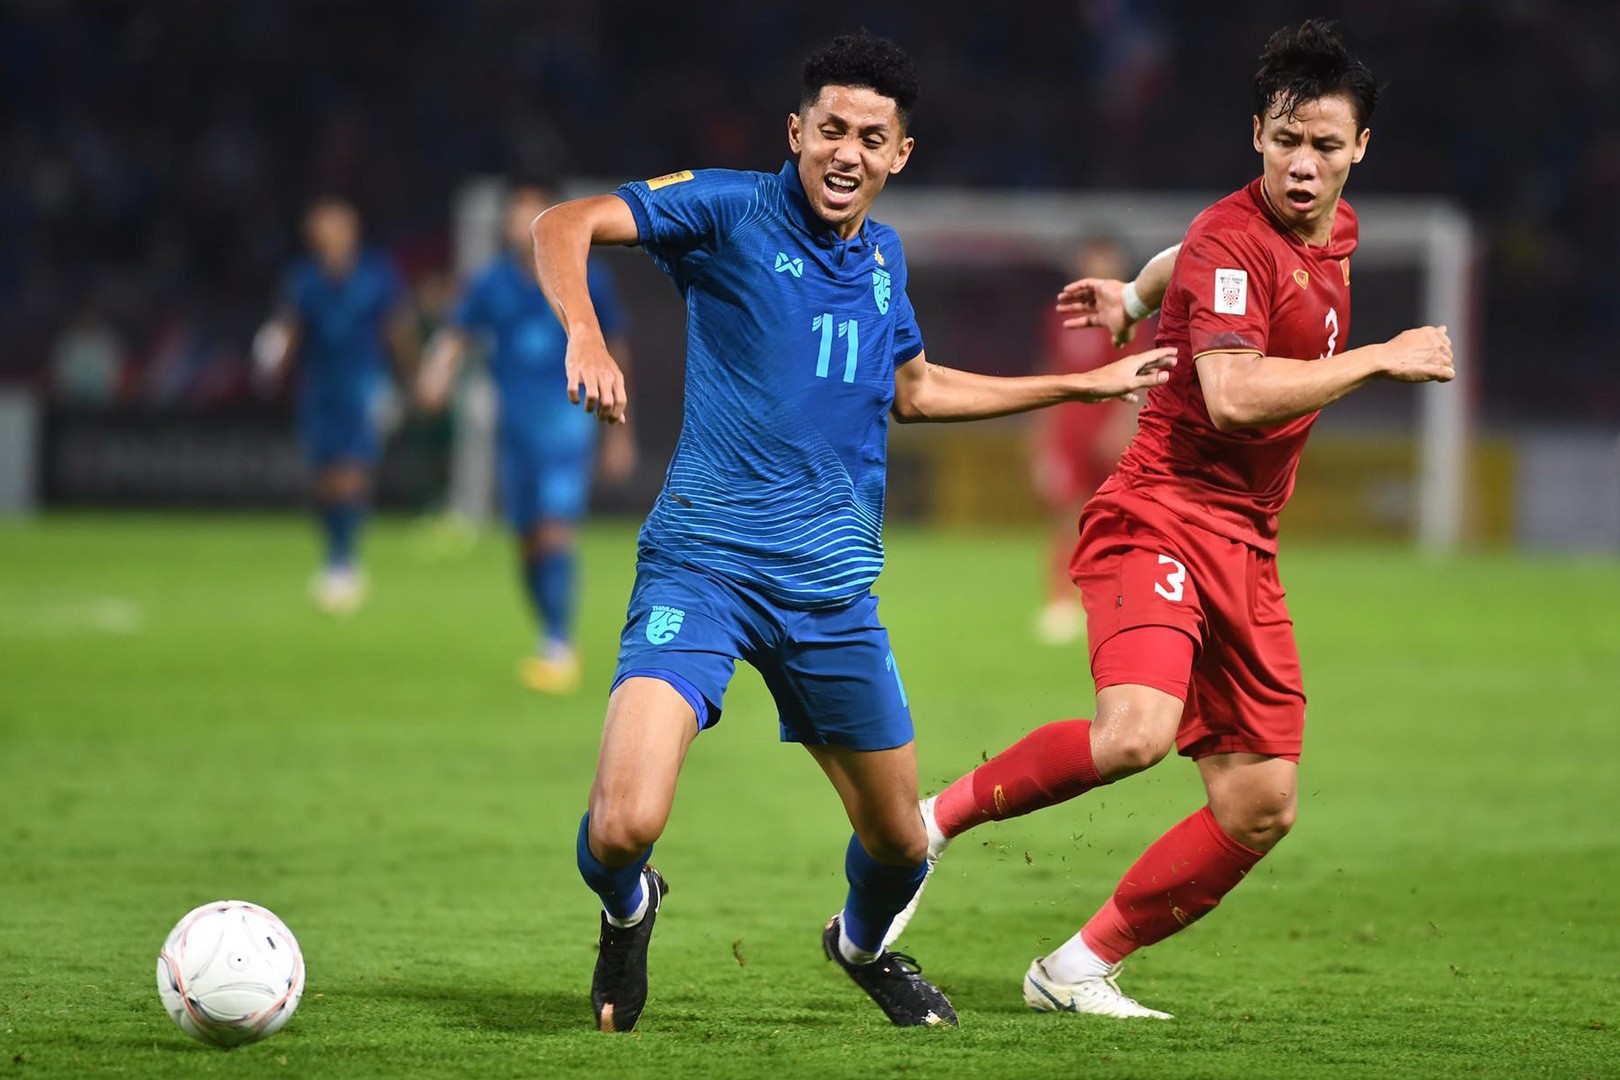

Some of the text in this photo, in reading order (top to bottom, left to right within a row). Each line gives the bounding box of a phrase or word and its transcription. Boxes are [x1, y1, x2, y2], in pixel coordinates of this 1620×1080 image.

[812, 313, 859, 384] 11
[1319, 307, 1339, 360] 3
[1154, 554, 1186, 602] 3
